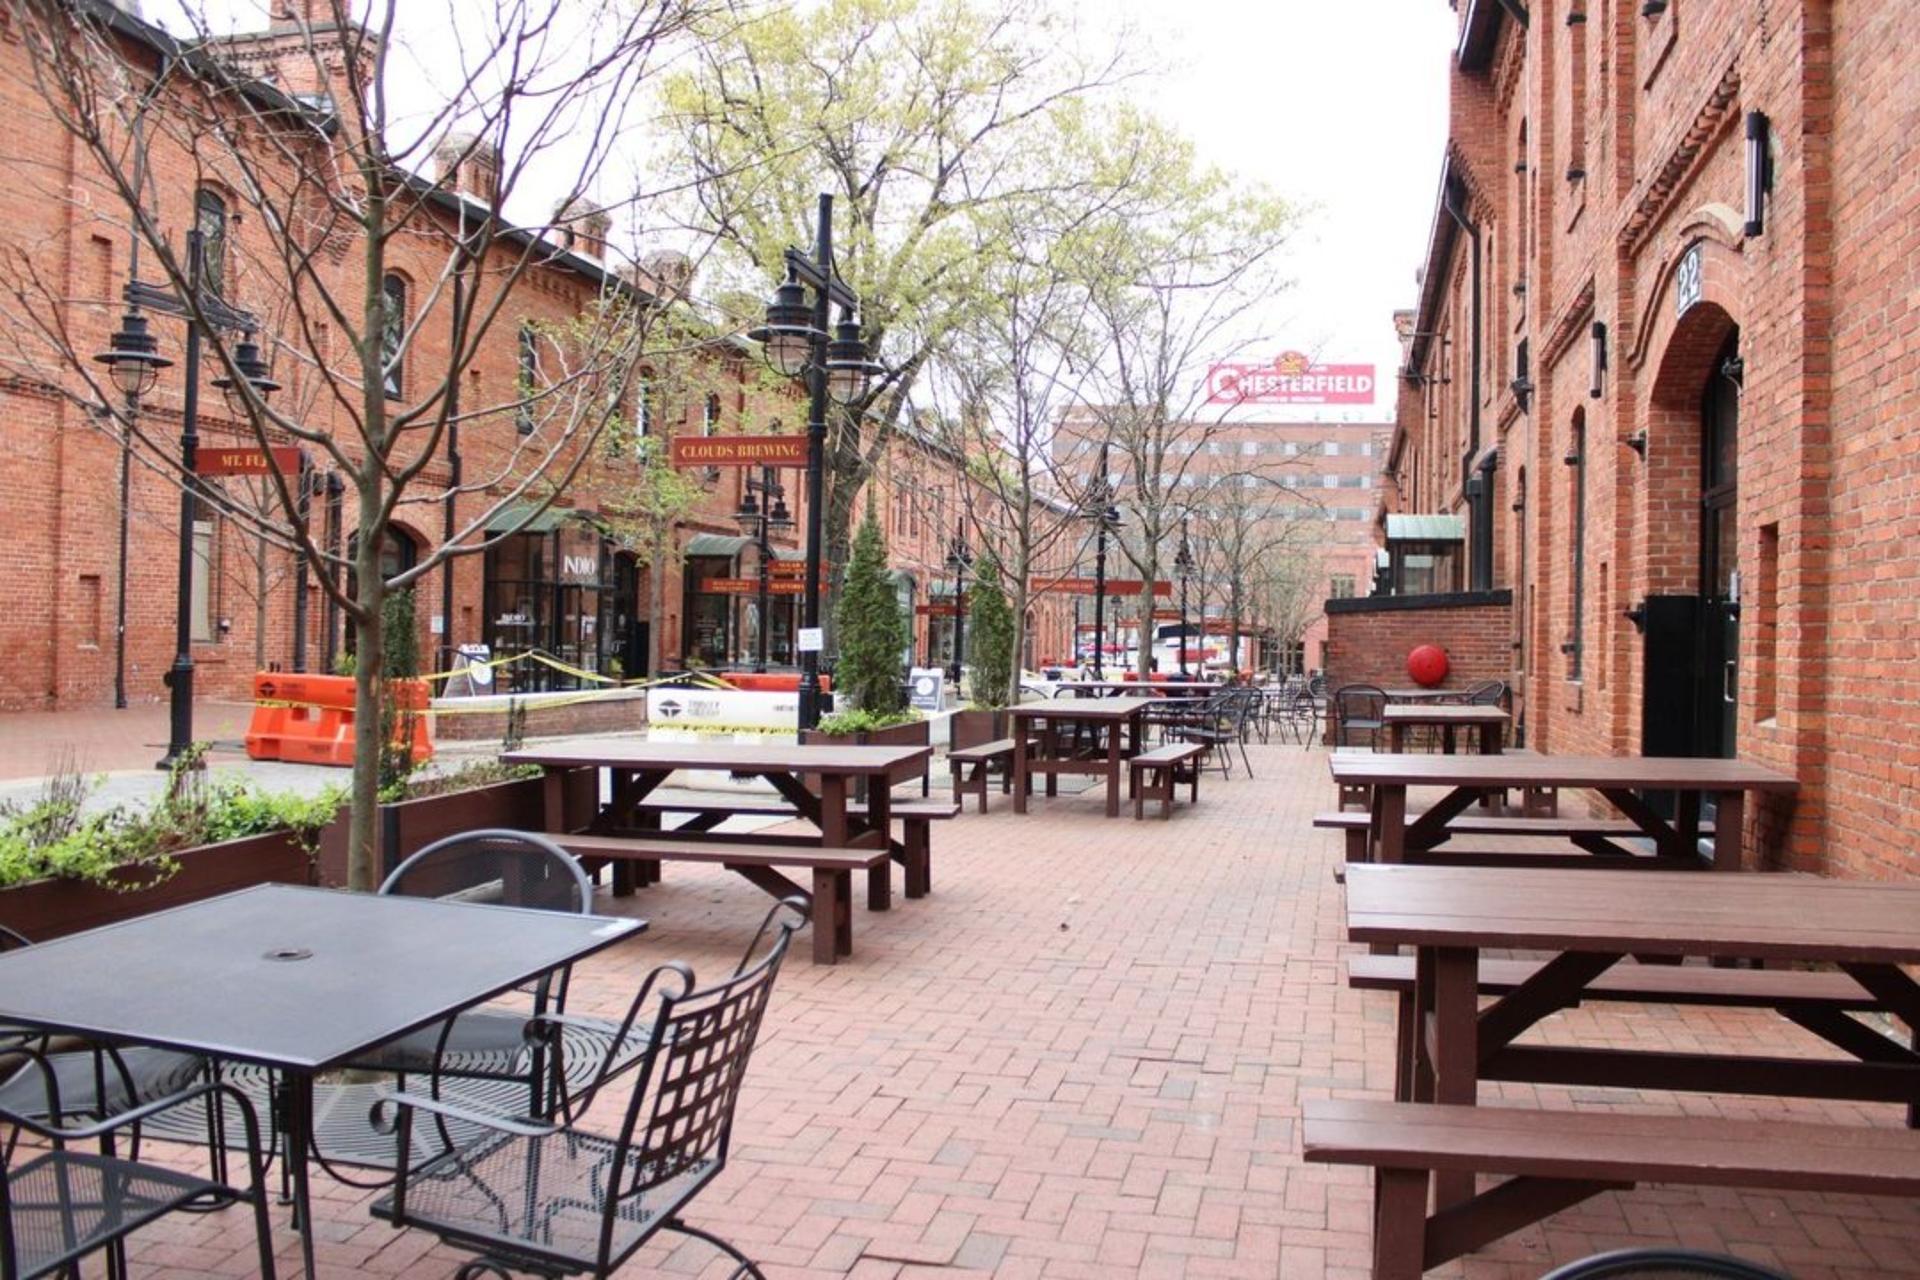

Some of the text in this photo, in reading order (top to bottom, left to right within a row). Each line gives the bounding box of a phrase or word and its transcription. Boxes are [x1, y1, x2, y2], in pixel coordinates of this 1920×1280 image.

[1679, 251, 1699, 309] 22
[1212, 368, 1372, 399] CHESTERFIELD
[681, 444, 800, 458] CLOUDS BREWING
